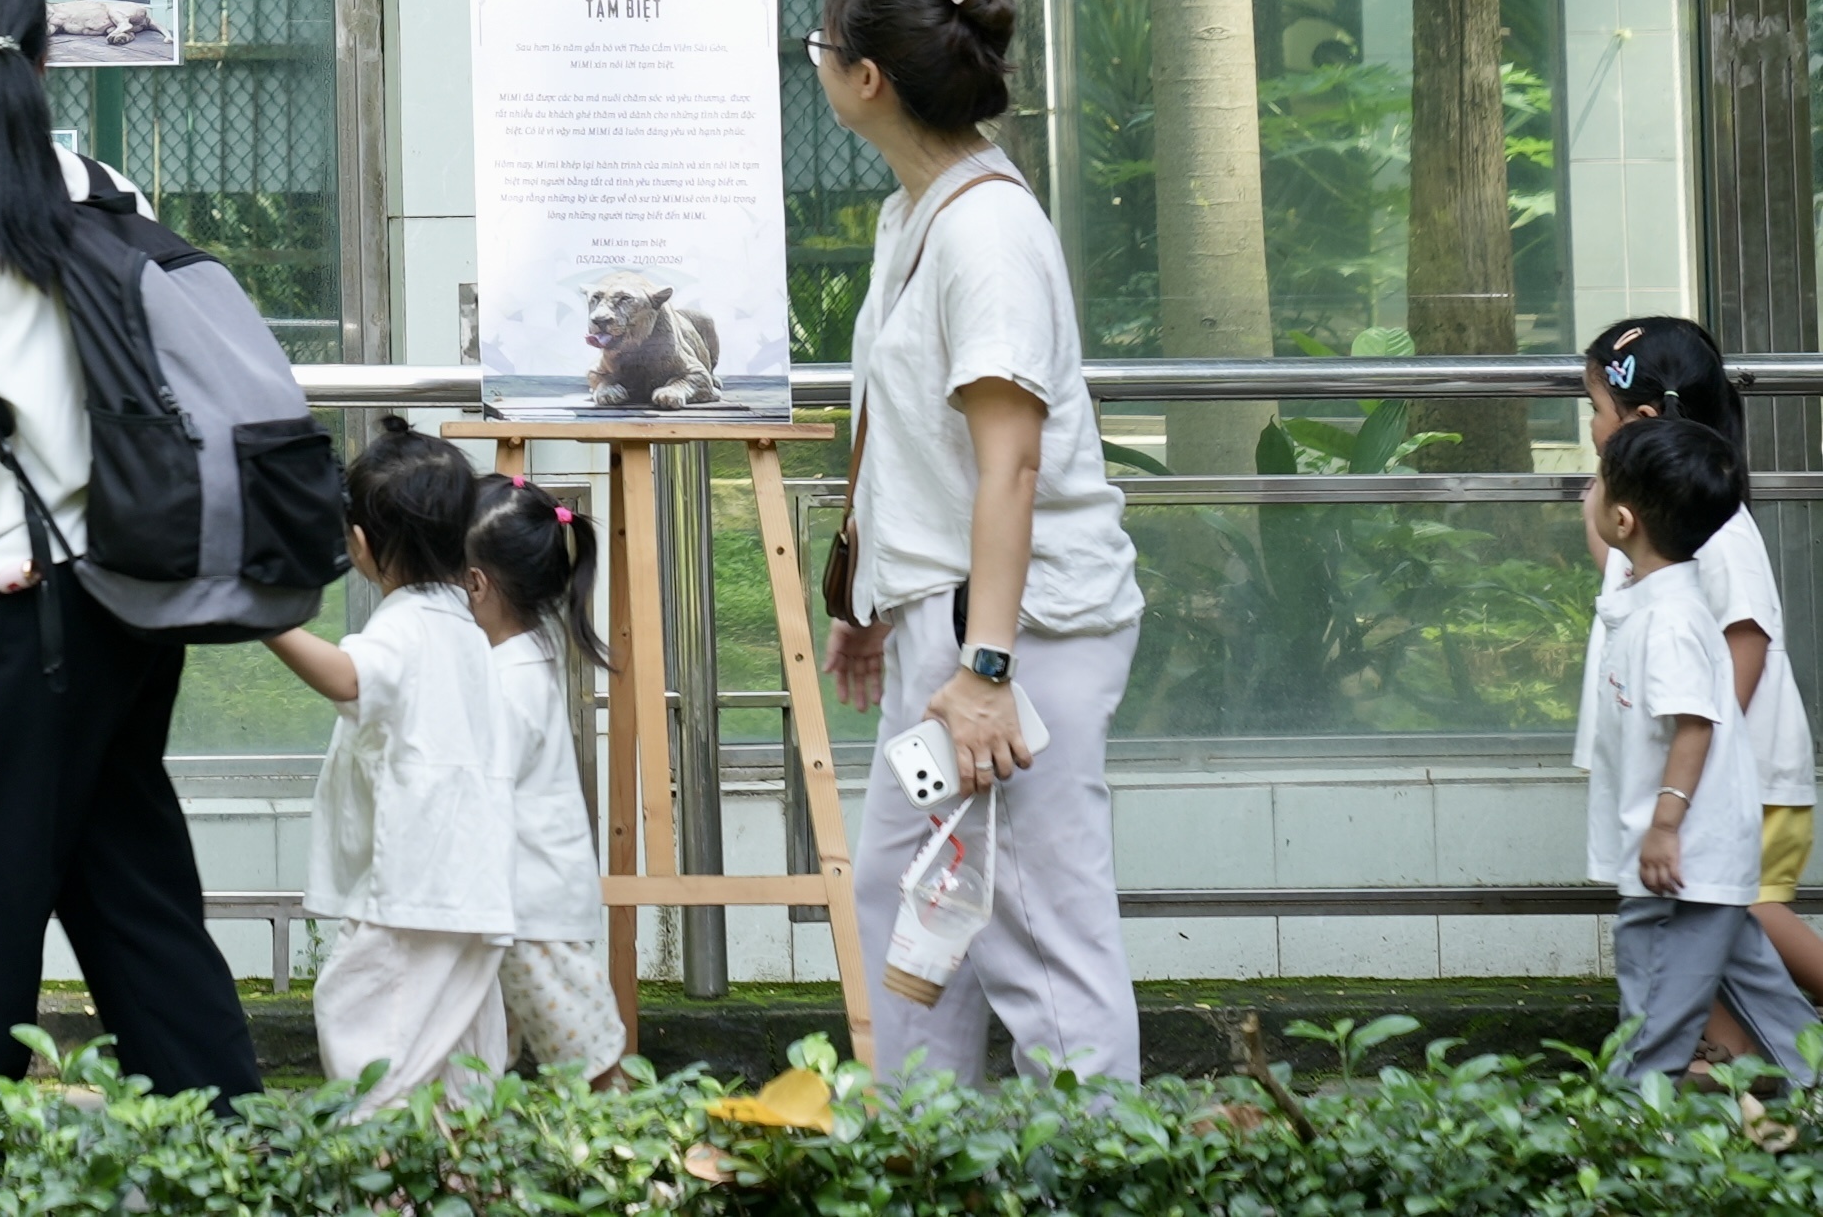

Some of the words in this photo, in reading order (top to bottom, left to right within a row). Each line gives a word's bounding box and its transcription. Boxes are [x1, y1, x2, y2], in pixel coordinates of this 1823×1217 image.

[585, 0, 618, 22] TẠM
[515, 43, 531, 51] Sau
[552, 43, 561, 51] 16
